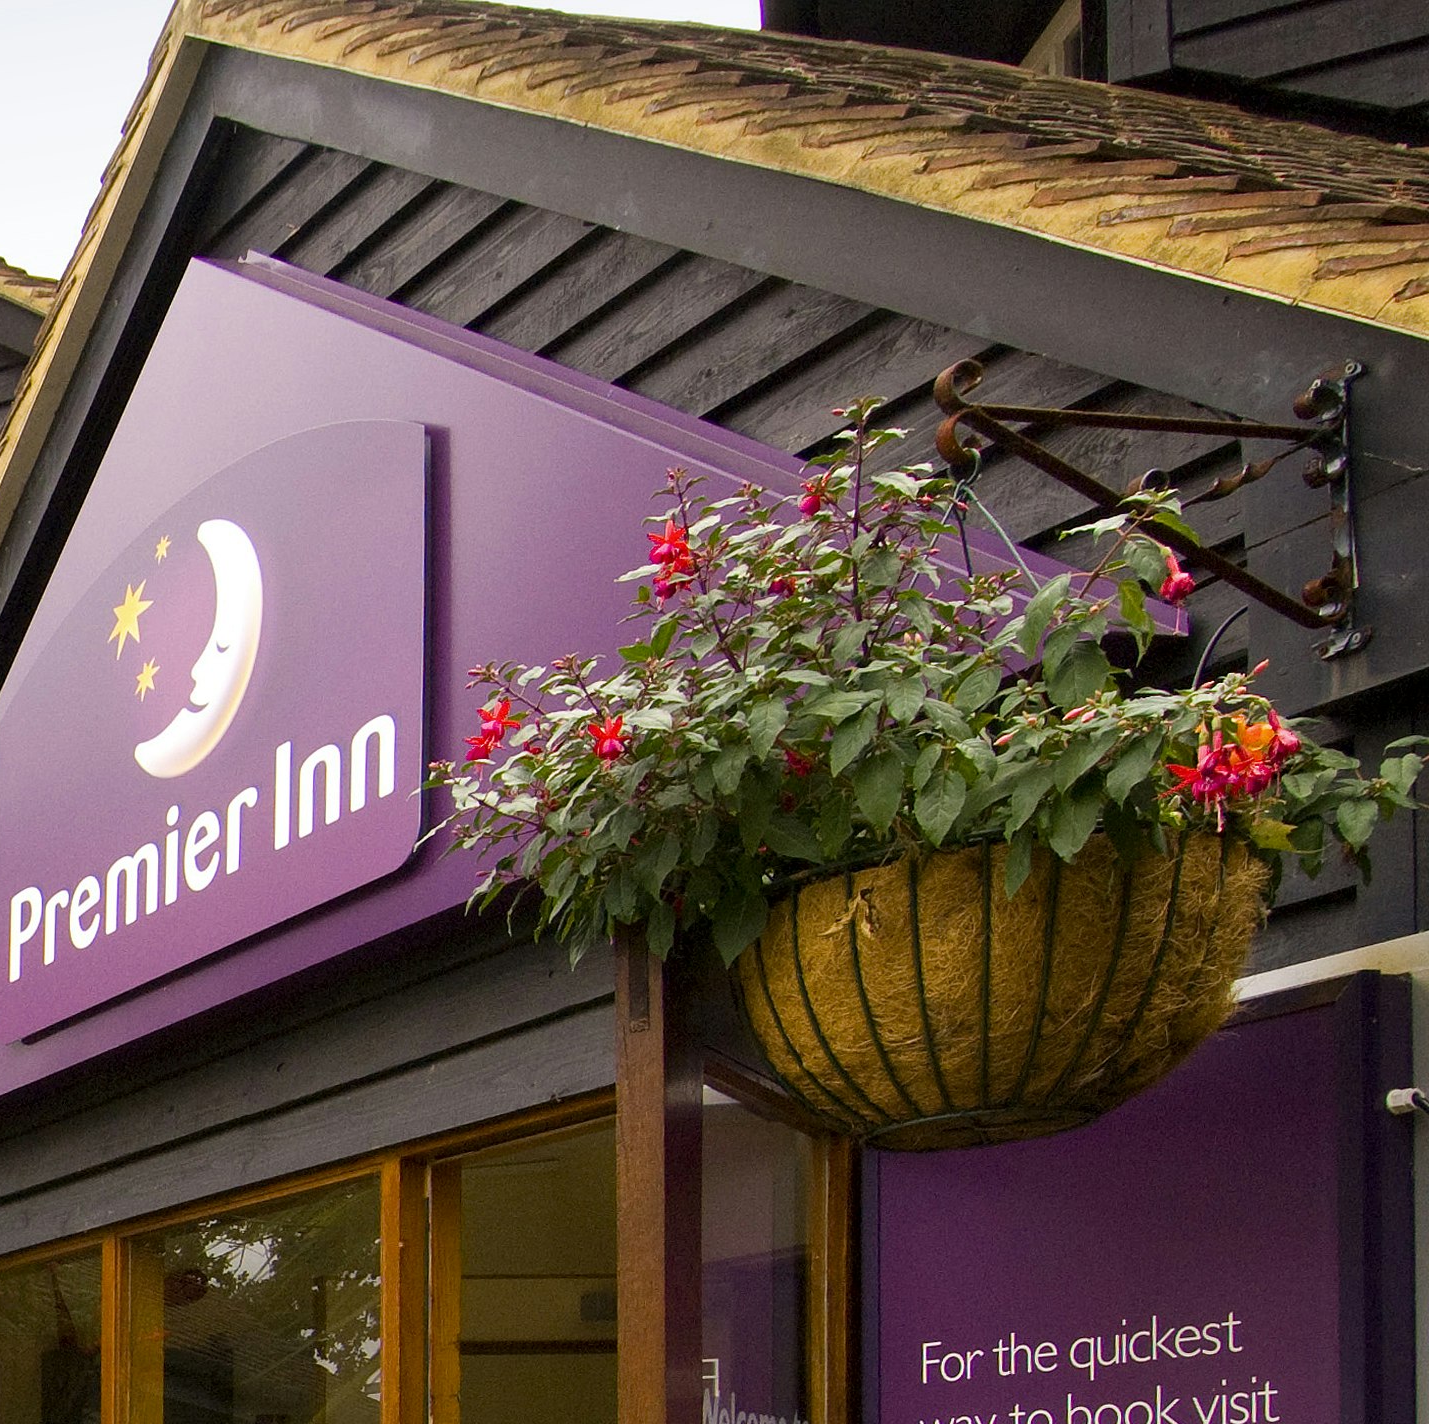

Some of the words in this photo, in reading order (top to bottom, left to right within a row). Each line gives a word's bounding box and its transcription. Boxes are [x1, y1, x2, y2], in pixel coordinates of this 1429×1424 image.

[9, 786, 259, 984] Premier
[274, 714, 397, 851] Inn
[921, 1341, 984, 1384] For
[992, 1332, 1058, 1377] the
[1069, 1311, 1243, 1381] quickest
